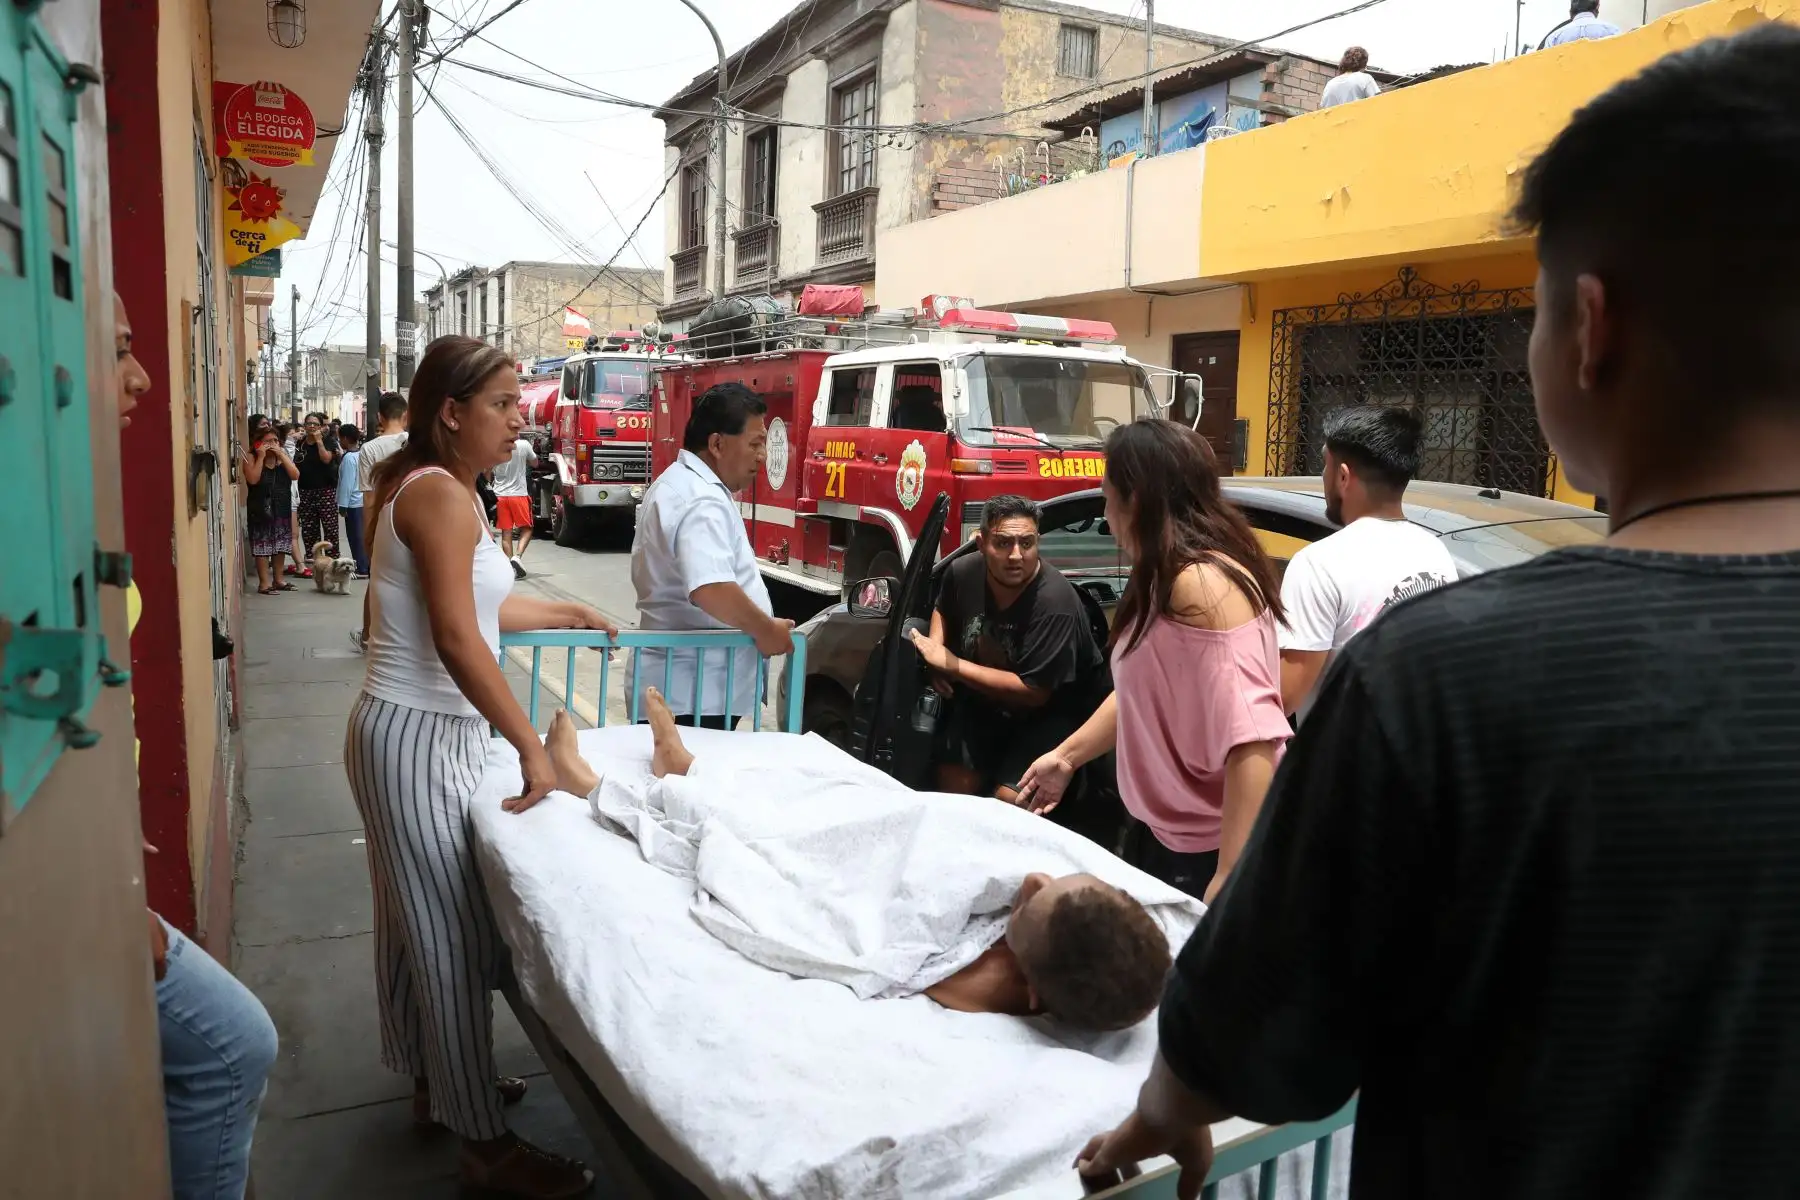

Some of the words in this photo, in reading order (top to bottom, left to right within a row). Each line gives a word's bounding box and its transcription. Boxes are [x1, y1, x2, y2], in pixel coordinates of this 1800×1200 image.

[237, 110, 252, 120] LA
[255, 112, 304, 126] BODEGA
[237, 121, 304, 140] ELEGIDA
[229, 229, 266, 240] Cerca
[247, 240, 261, 253] ti
[825, 441, 856, 459] RIMAC
[825, 461, 847, 498] 21
